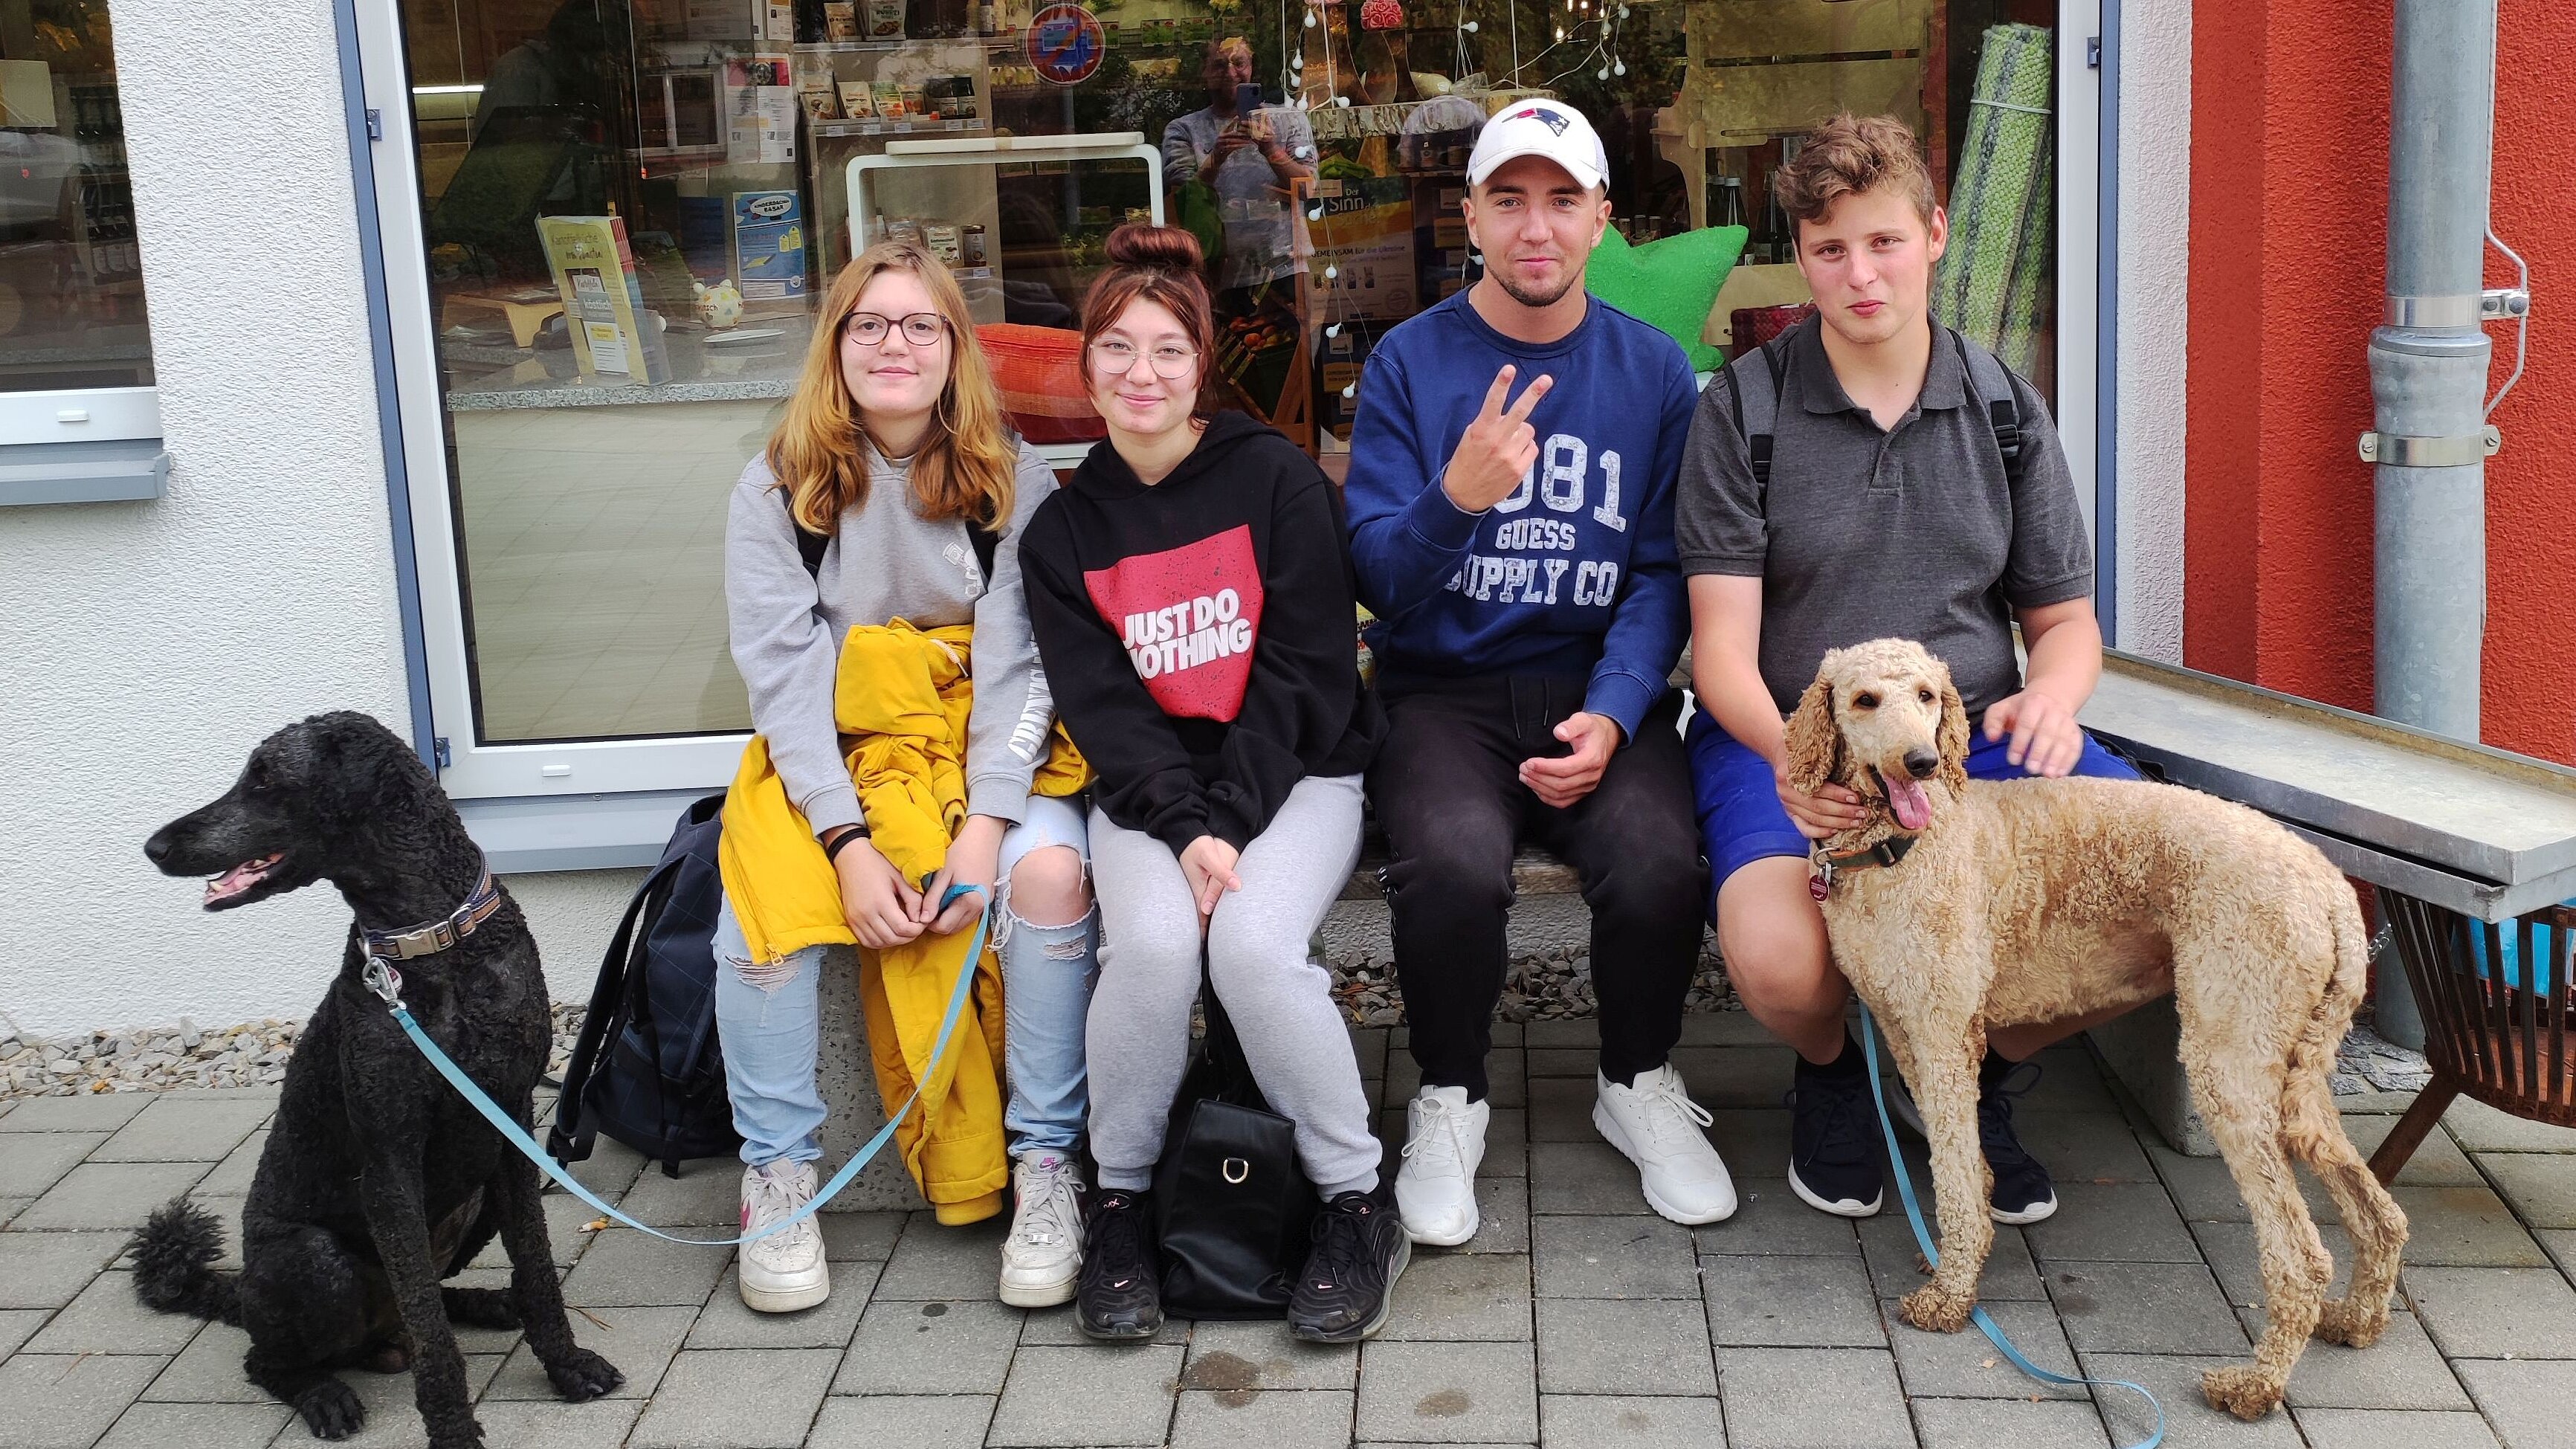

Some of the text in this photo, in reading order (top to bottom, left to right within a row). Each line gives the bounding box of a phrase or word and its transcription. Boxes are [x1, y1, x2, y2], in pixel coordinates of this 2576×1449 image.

[1329, 196, 1363, 213] Sinn
[1495, 518, 1576, 551] GUESS
[1573, 560, 1619, 607] CO
[1123, 588, 1239, 651] JUST DO
